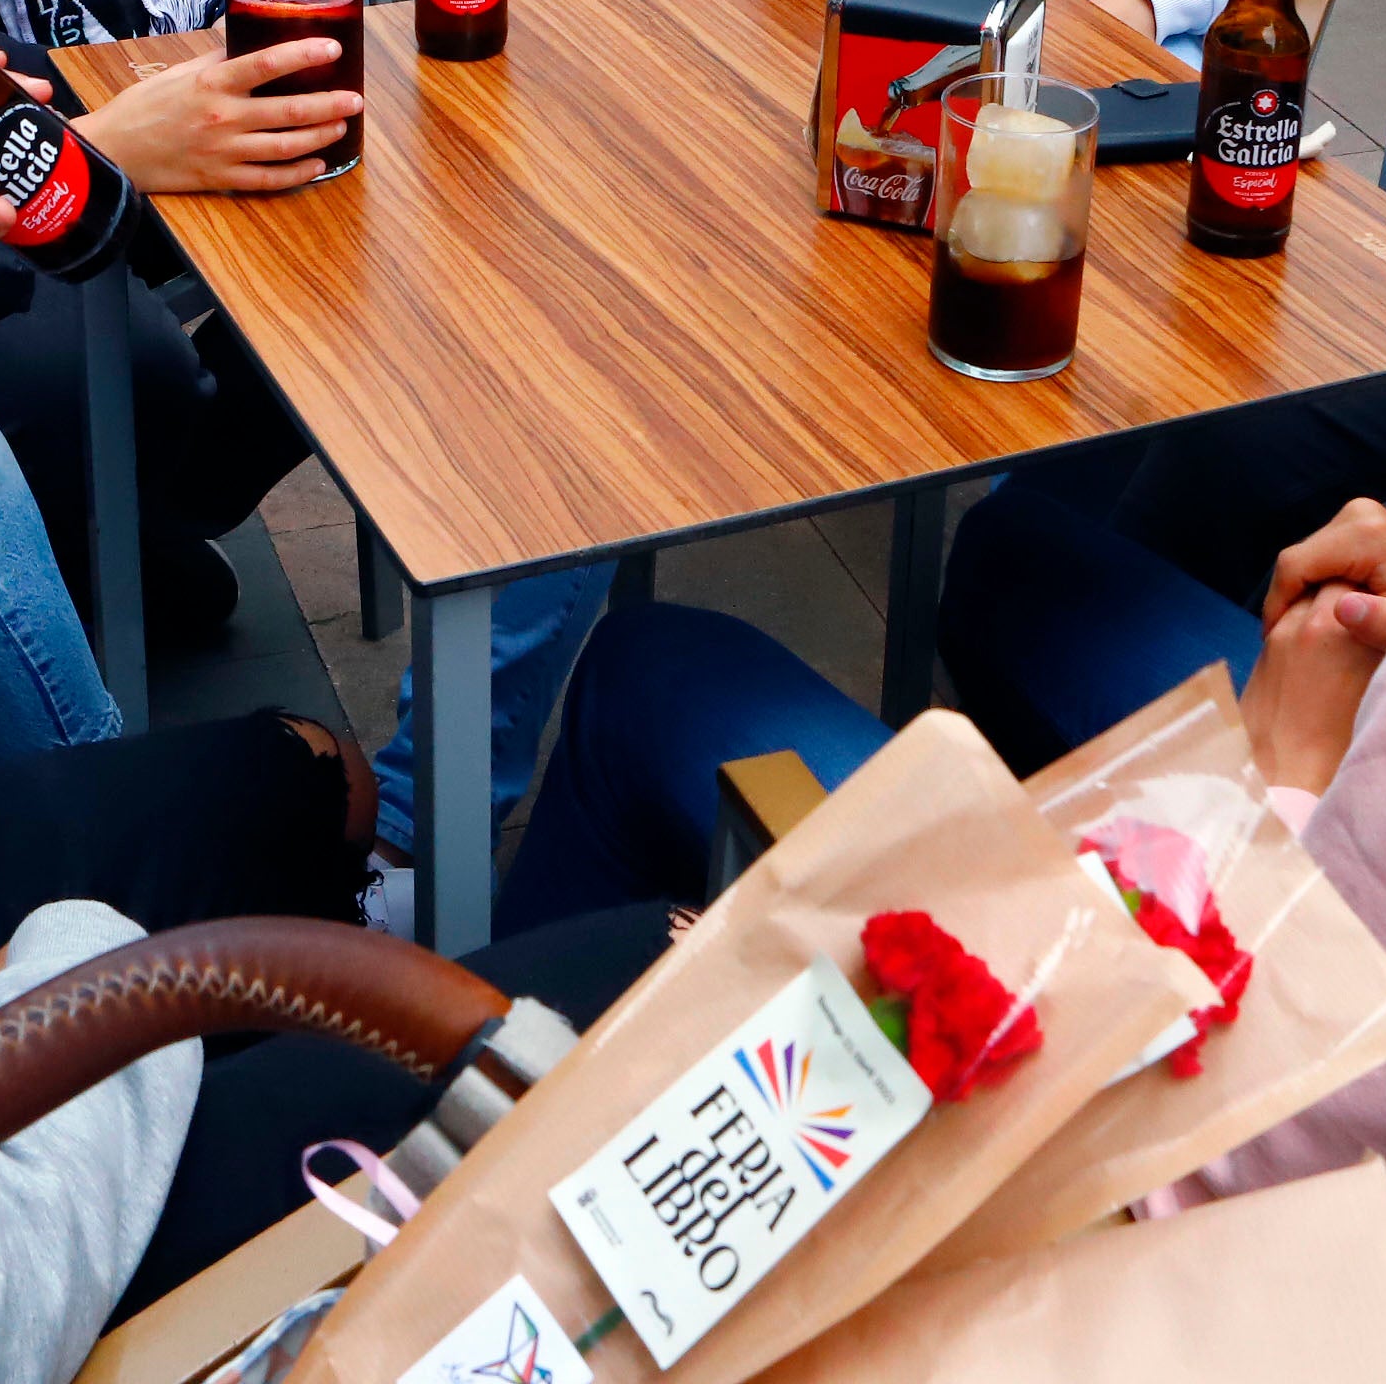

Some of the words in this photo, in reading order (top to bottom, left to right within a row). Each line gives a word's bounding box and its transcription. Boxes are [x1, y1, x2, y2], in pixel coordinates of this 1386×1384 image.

[1215, 114, 1299, 143] Estrella
[1217, 138, 1294, 166] Galicia
[843, 166, 926, 202] Coca-Cola
[1232, 172, 1278, 190] Especial
[21, 181, 70, 230] Especial
[26, 188, 52, 213] CERVEZA
[690, 1083, 797, 1232] FERIA
[678, 1146, 755, 1226] del
[622, 1134, 741, 1293] LIBRO
